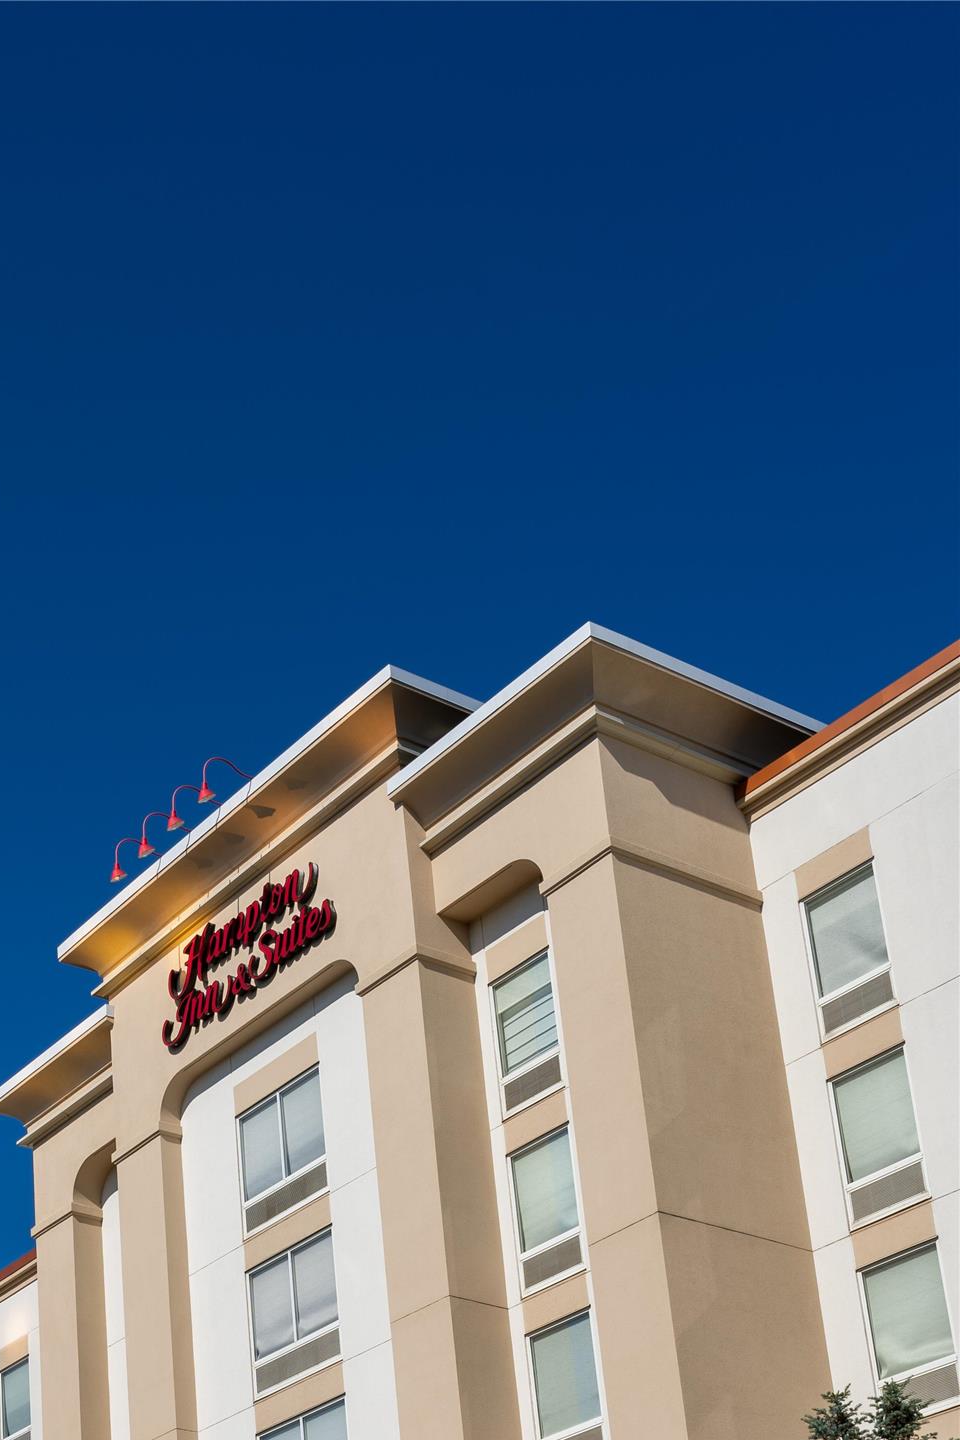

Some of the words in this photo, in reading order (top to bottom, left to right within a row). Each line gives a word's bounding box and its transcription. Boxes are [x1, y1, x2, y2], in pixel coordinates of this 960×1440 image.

[161, 974, 235, 1047] Inn
[231, 963, 251, 997] &
[248, 898, 337, 981] Suites
[168, 861, 319, 1001] Hampton
